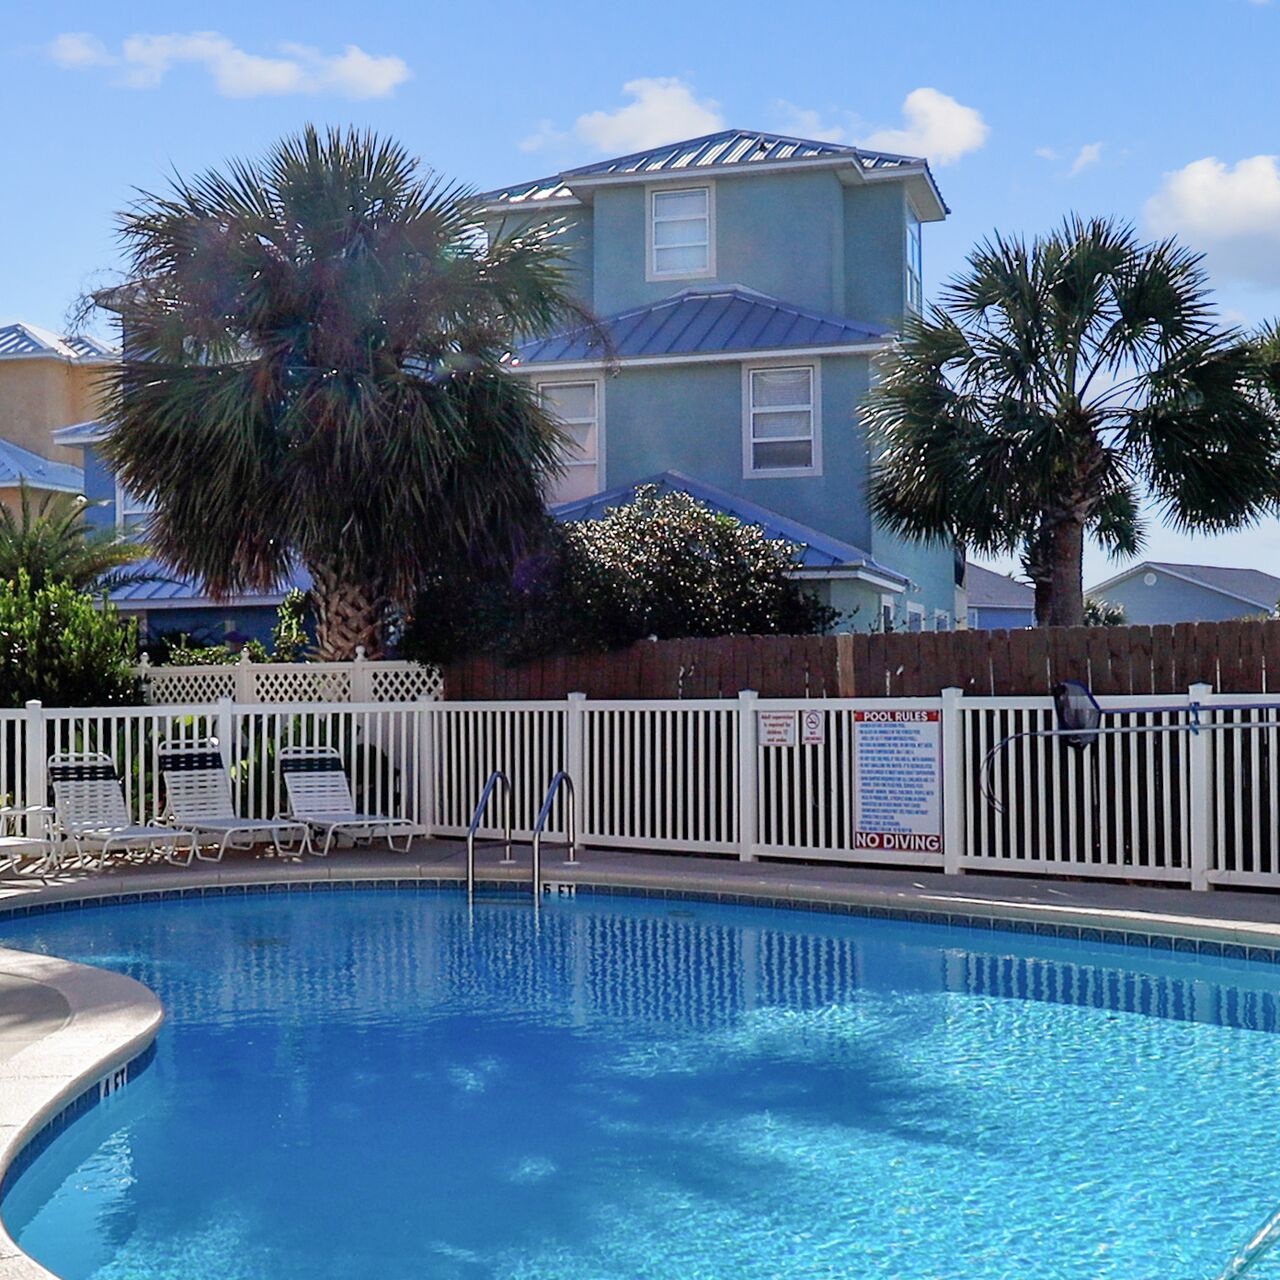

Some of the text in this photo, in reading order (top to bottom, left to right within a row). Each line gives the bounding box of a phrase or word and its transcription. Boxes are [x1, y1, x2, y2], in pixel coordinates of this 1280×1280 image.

[864, 711, 928, 721] POOL RULES
[856, 833, 939, 850] NO DIVING
